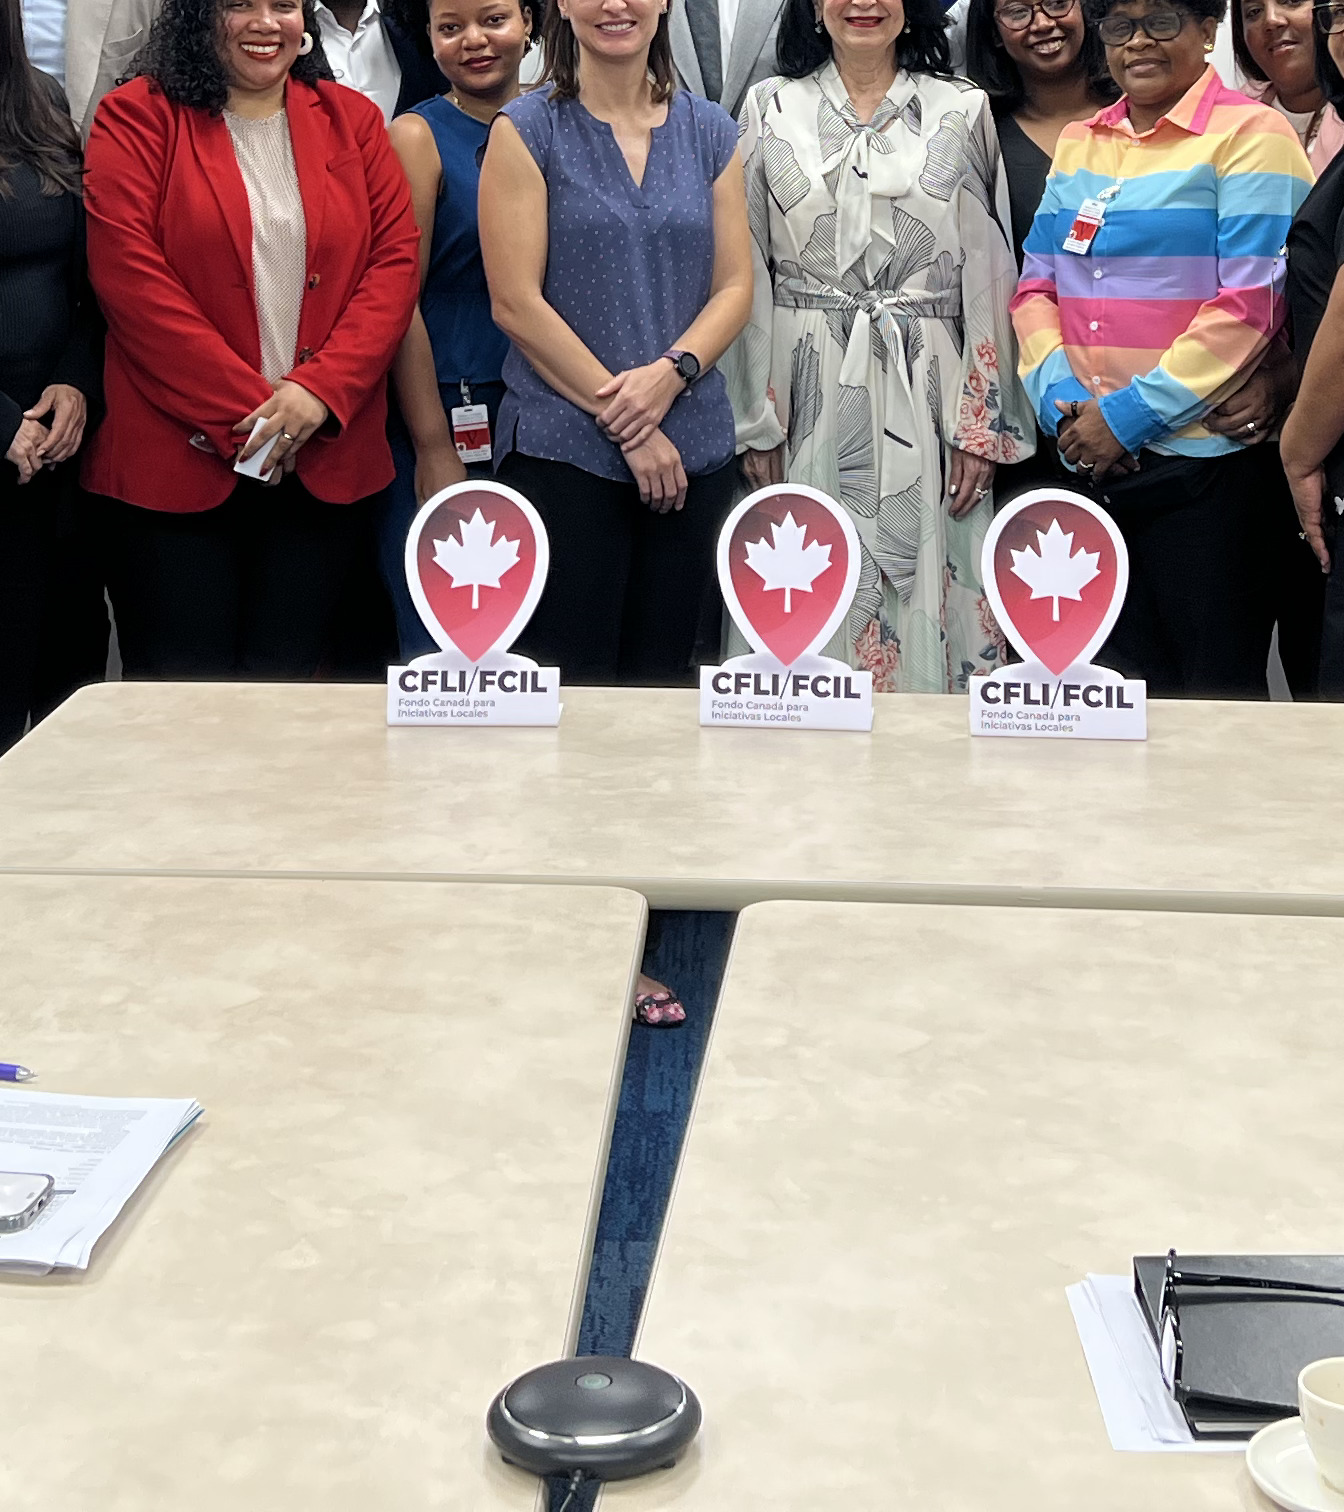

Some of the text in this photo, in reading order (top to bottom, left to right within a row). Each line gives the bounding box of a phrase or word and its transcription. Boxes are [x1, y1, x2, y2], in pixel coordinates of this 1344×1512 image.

[398, 666, 548, 696] CFLI/FCIL
[711, 670, 861, 700] CFLI/FCIL
[980, 679, 1134, 709] CFLI/FCIL
[398, 698, 496, 710] Fondo Canadá para
[711, 700, 809, 714] Fondo Canadá para
[398, 709, 489, 718] Iniciativas Locales
[711, 710, 802, 722] Iniciativas Locales
[981, 710, 1081, 724] Fondo Canadá para
[981, 720, 1074, 733] Iniciativas Locales
